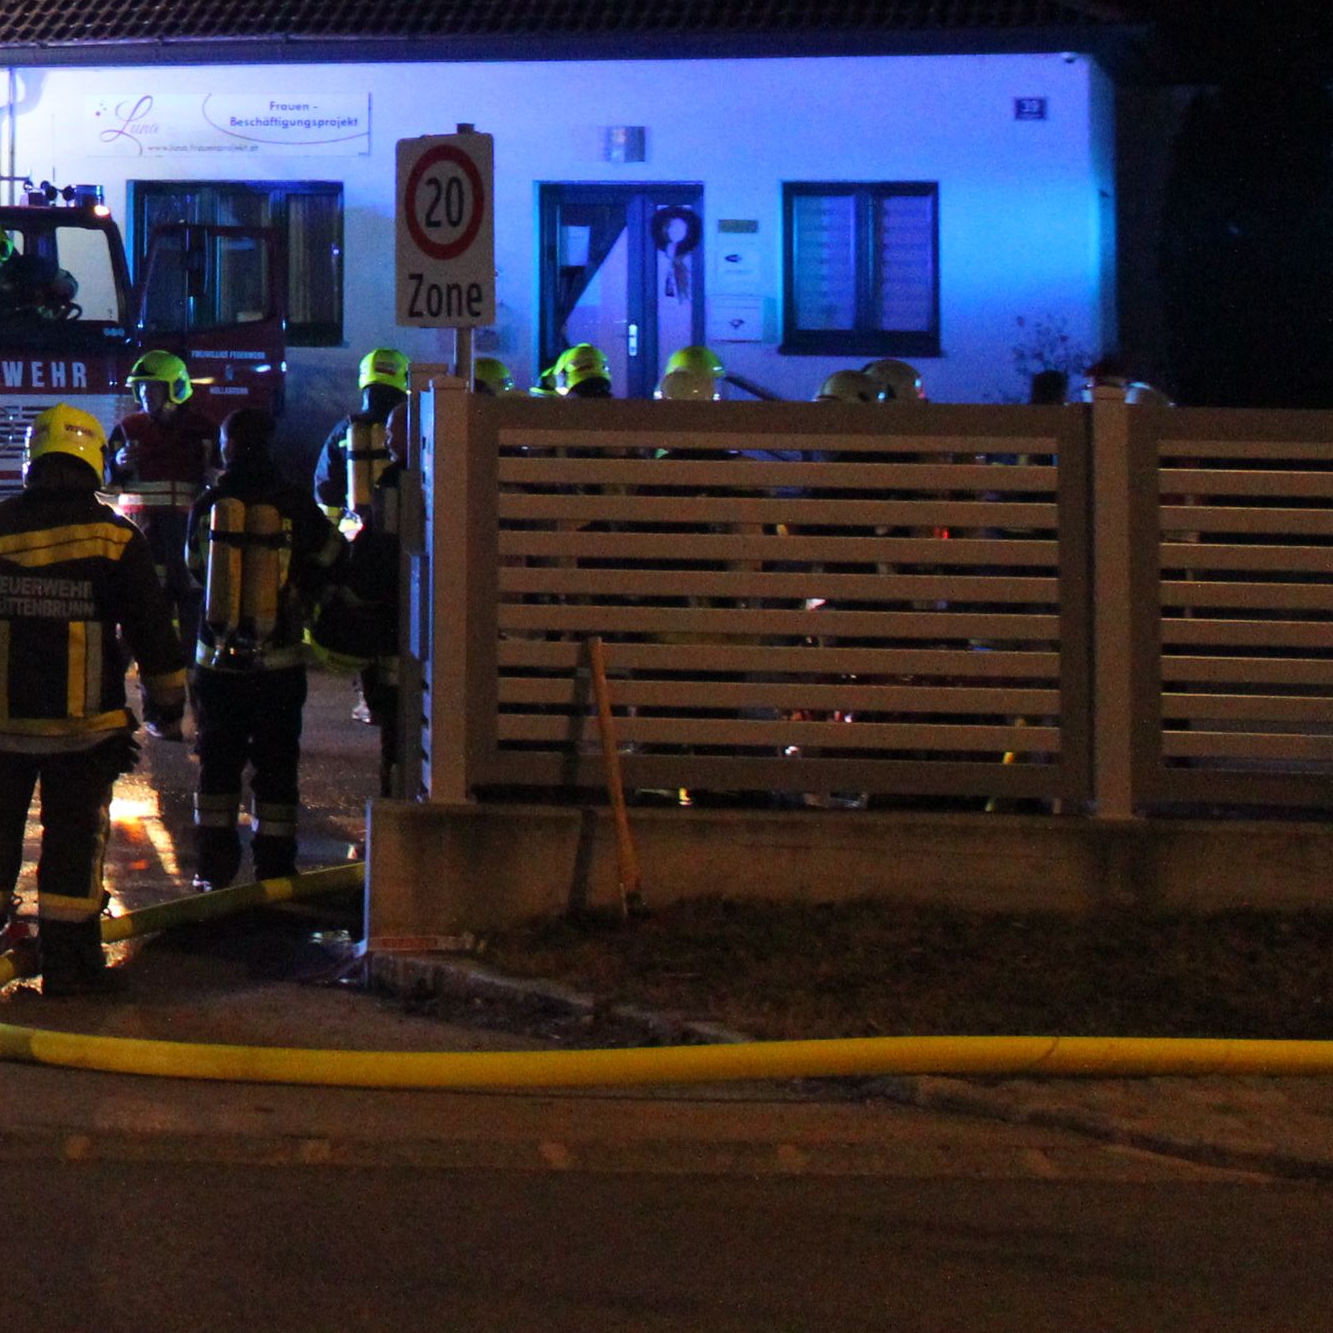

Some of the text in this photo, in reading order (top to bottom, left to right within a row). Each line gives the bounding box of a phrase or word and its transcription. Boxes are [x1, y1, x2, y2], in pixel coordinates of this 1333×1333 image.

[269, 100, 310, 112] Frauen
[229, 115, 359, 130] Beschäftigungsprojekt
[424, 176, 465, 228] 20
[407, 272, 483, 318] Zone
